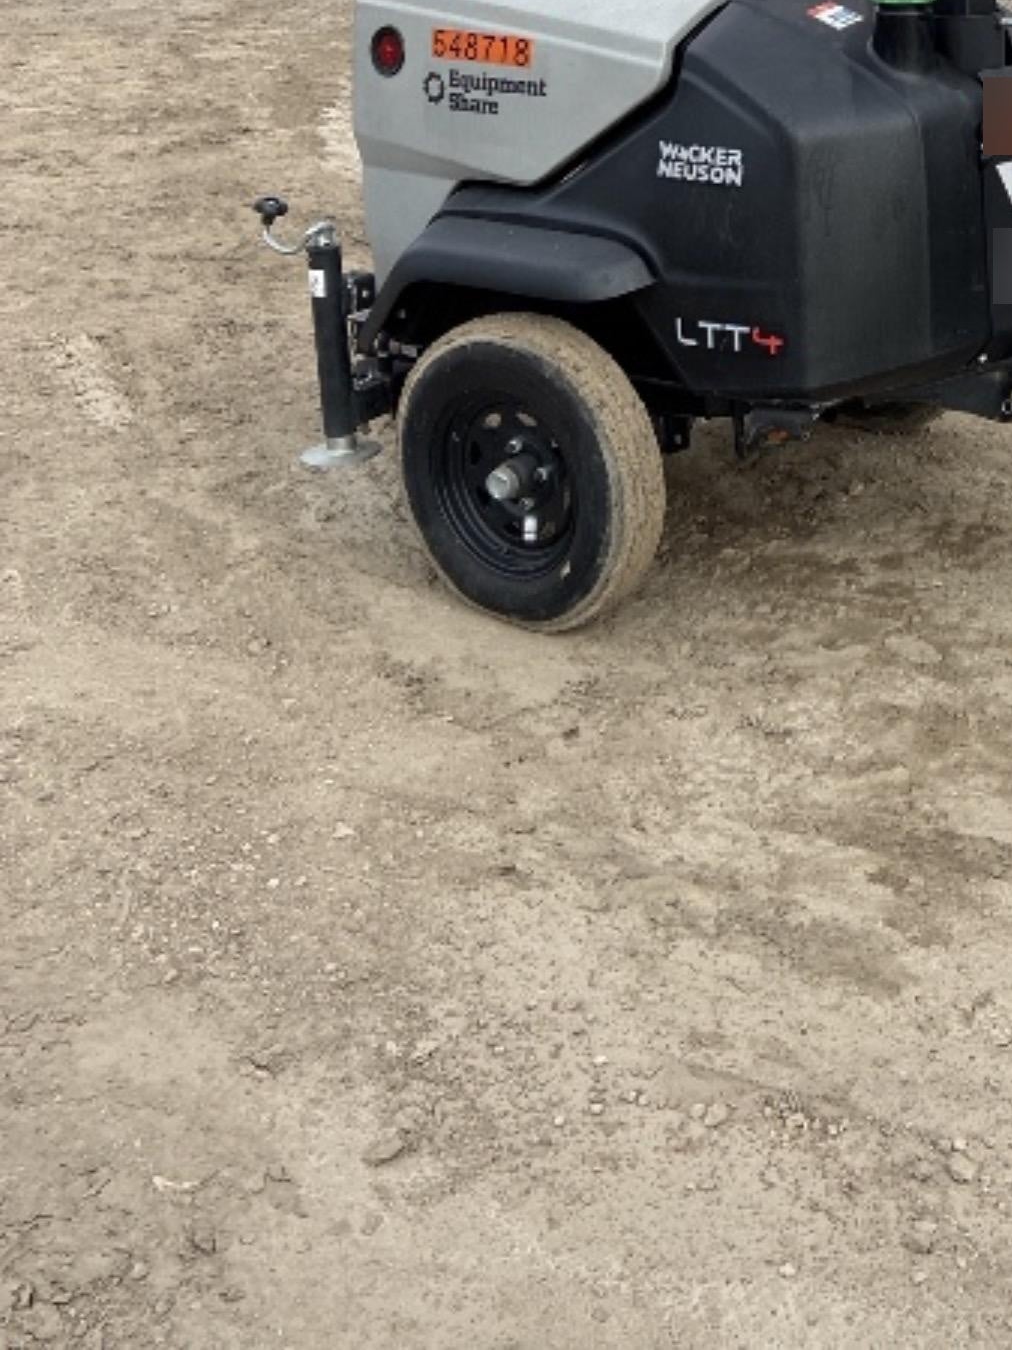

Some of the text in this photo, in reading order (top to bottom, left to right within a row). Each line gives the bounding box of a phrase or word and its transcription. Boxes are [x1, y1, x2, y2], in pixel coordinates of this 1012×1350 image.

[433, 29, 530, 67] 548718
[448, 68, 547, 97] Equipment
[448, 92, 499, 115] Share
[658, 140, 743, 166] WACKER
[656, 158, 744, 187] NEUSON
[675, 317, 785, 356] LTT4
